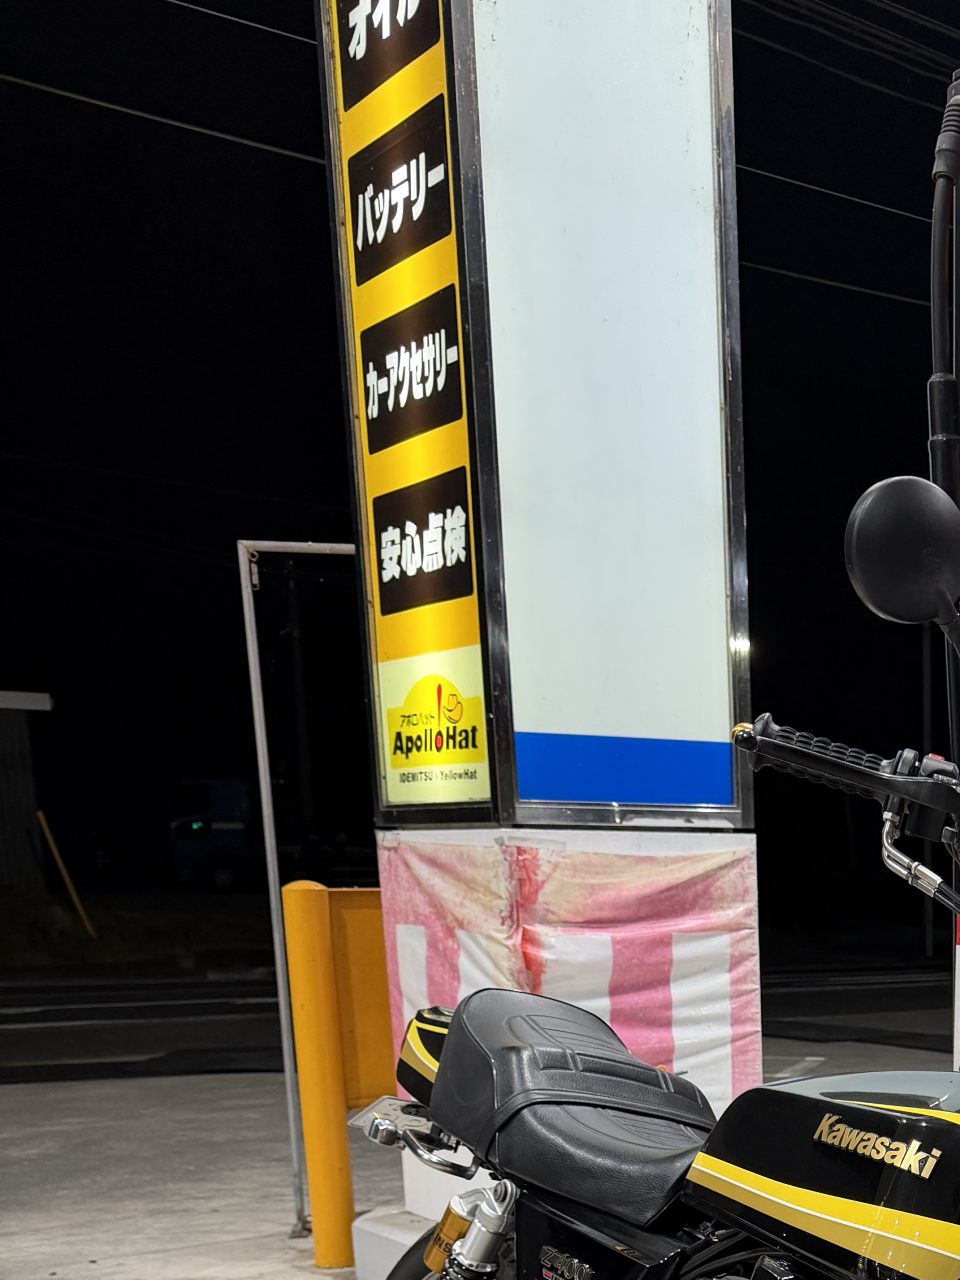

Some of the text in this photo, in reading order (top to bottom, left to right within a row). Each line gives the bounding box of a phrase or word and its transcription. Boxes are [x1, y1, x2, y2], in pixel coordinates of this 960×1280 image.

[356, 152, 445, 252] バッテリー
[366, 329, 459, 420] カーアクセサリー
[381, 505, 466, 583] 安心点検
[812, 1112, 943, 1180] Kawasaki
